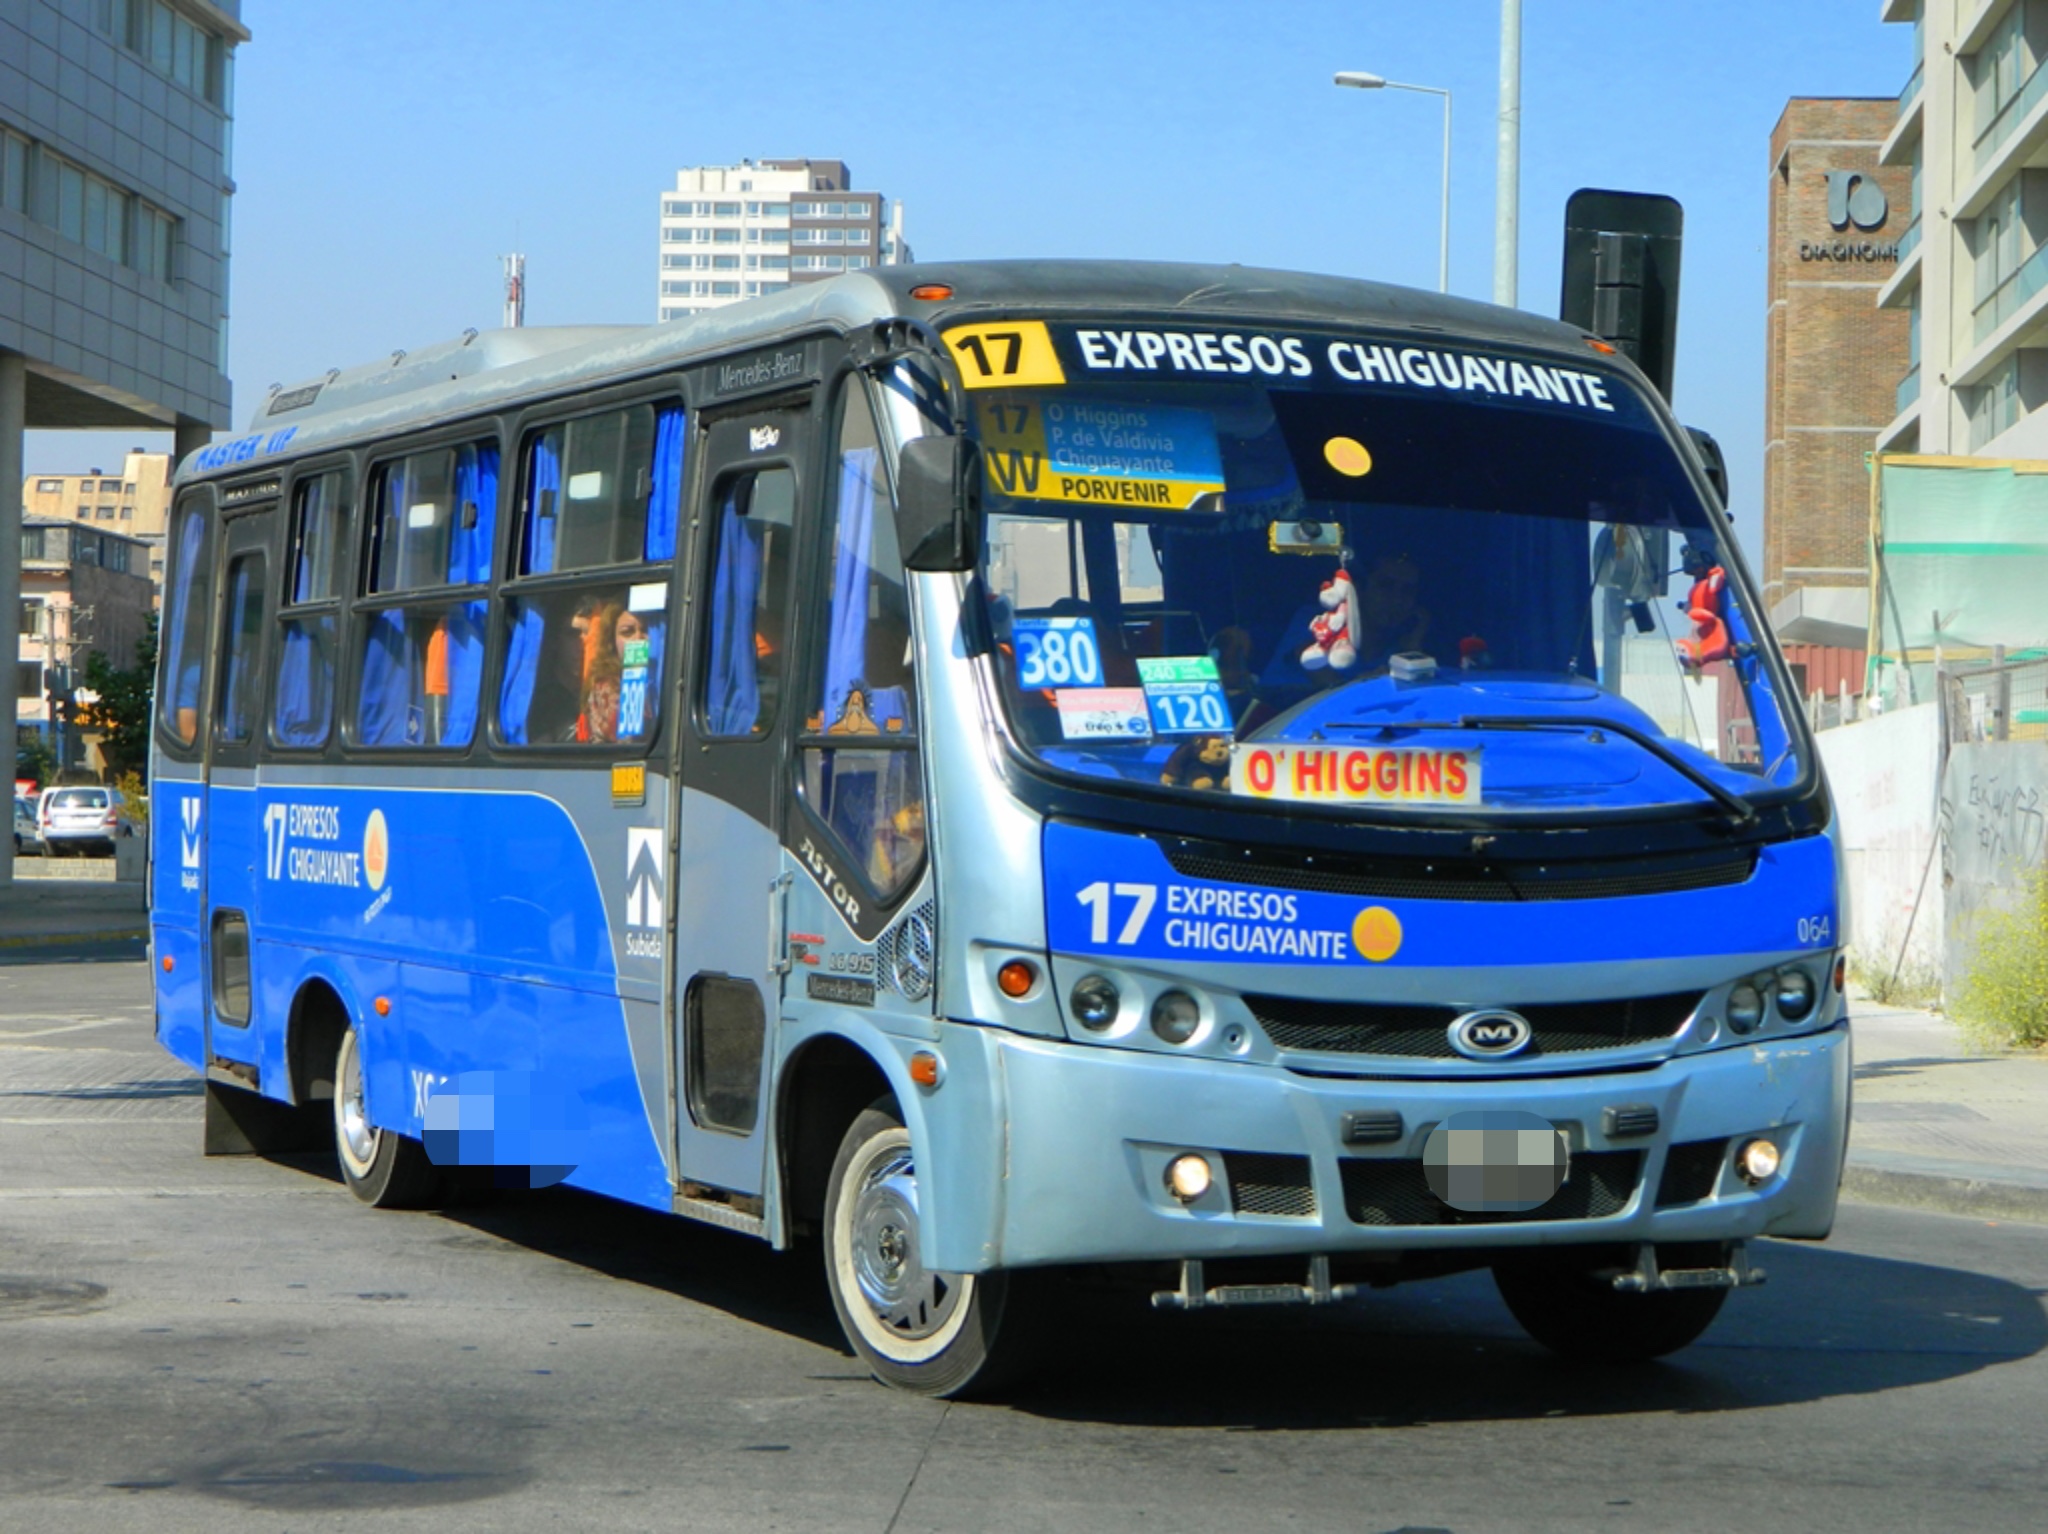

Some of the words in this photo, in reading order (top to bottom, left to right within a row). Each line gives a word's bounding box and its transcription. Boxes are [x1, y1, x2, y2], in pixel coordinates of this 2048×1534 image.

[718, 352, 803, 391] Mercedes-Benz
[956, 331, 1023, 376] 17
[1077, 330, 1312, 377] EXPRESOS
[1327, 342, 1615, 412] CHIGUAYANTE
[988, 404, 1030, 434] 17
[1075, 406, 1148, 430] Higgins
[1052, 427, 1067, 443] P.
[1072, 428, 1095, 447] de
[1100, 429, 1174, 452] Valdivia
[988, 448, 1041, 493] W
[1055, 448, 1175, 474] Chiguayante
[1060, 478, 1172, 504] PORVENIR
[1018, 631, 1098, 684] 380
[618, 679, 645, 735] 380
[1156, 694, 1226, 729] 120
[1295, 750, 1469, 796] HIGGINS
[264, 802, 287, 880] 17
[289, 803, 340, 841] EXPRESOS
[288, 847, 361, 888] CHIGUAYANTE
[799, 836, 861, 923] ASTOR
[1075, 881, 1158, 945] 17
[1166, 885, 1299, 923] EXPRESOS
[626, 932, 661, 958] Subida
[1164, 918, 1348, 960] CHIGUAYANTE
[1797, 916, 1831, 943] 064
[848, 954, 874, 974] 915
[1474, 1026, 1514, 1041] M
